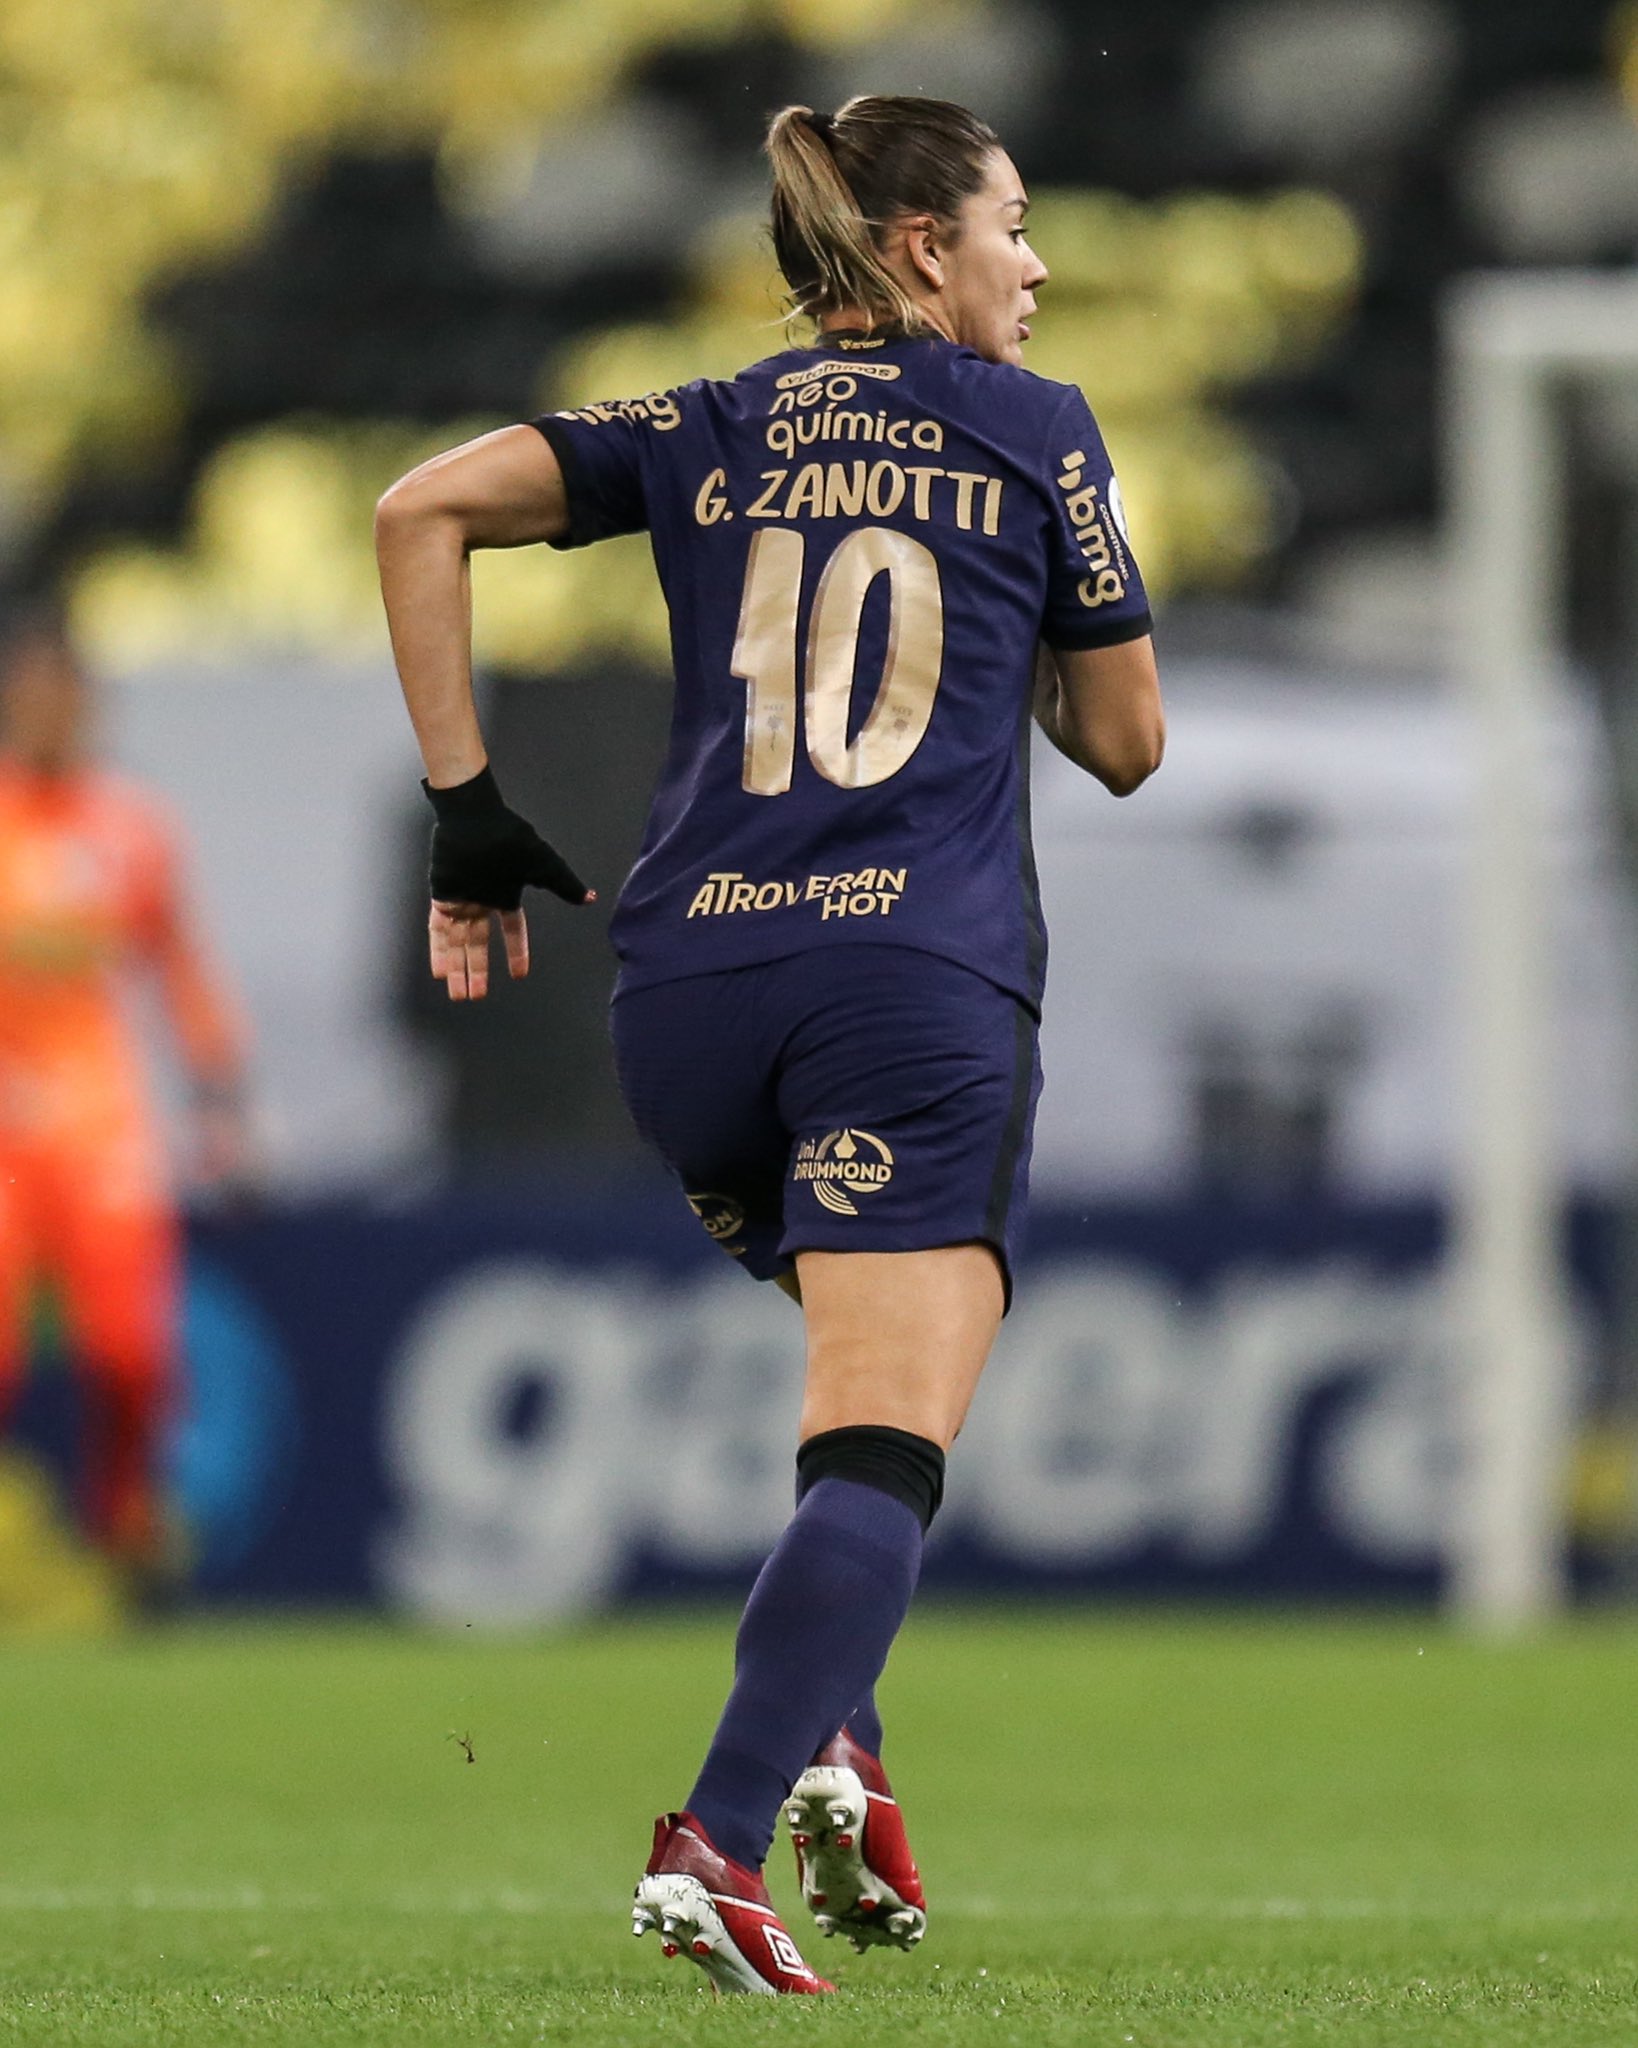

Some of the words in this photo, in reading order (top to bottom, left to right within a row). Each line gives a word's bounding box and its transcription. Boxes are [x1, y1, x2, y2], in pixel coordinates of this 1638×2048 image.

[768, 374, 858, 416] neo
[766, 402, 944, 460] química
[694, 466, 734, 527] G.
[745, 459, 1003, 537] ZANOTTI
[1065, 484, 1126, 608] bmg
[729, 525, 944, 797] 10
[686, 868, 908, 919] ATROVERAN
[821, 892, 900, 921] HOT
[793, 1161, 893, 1183] DRUMMOND
